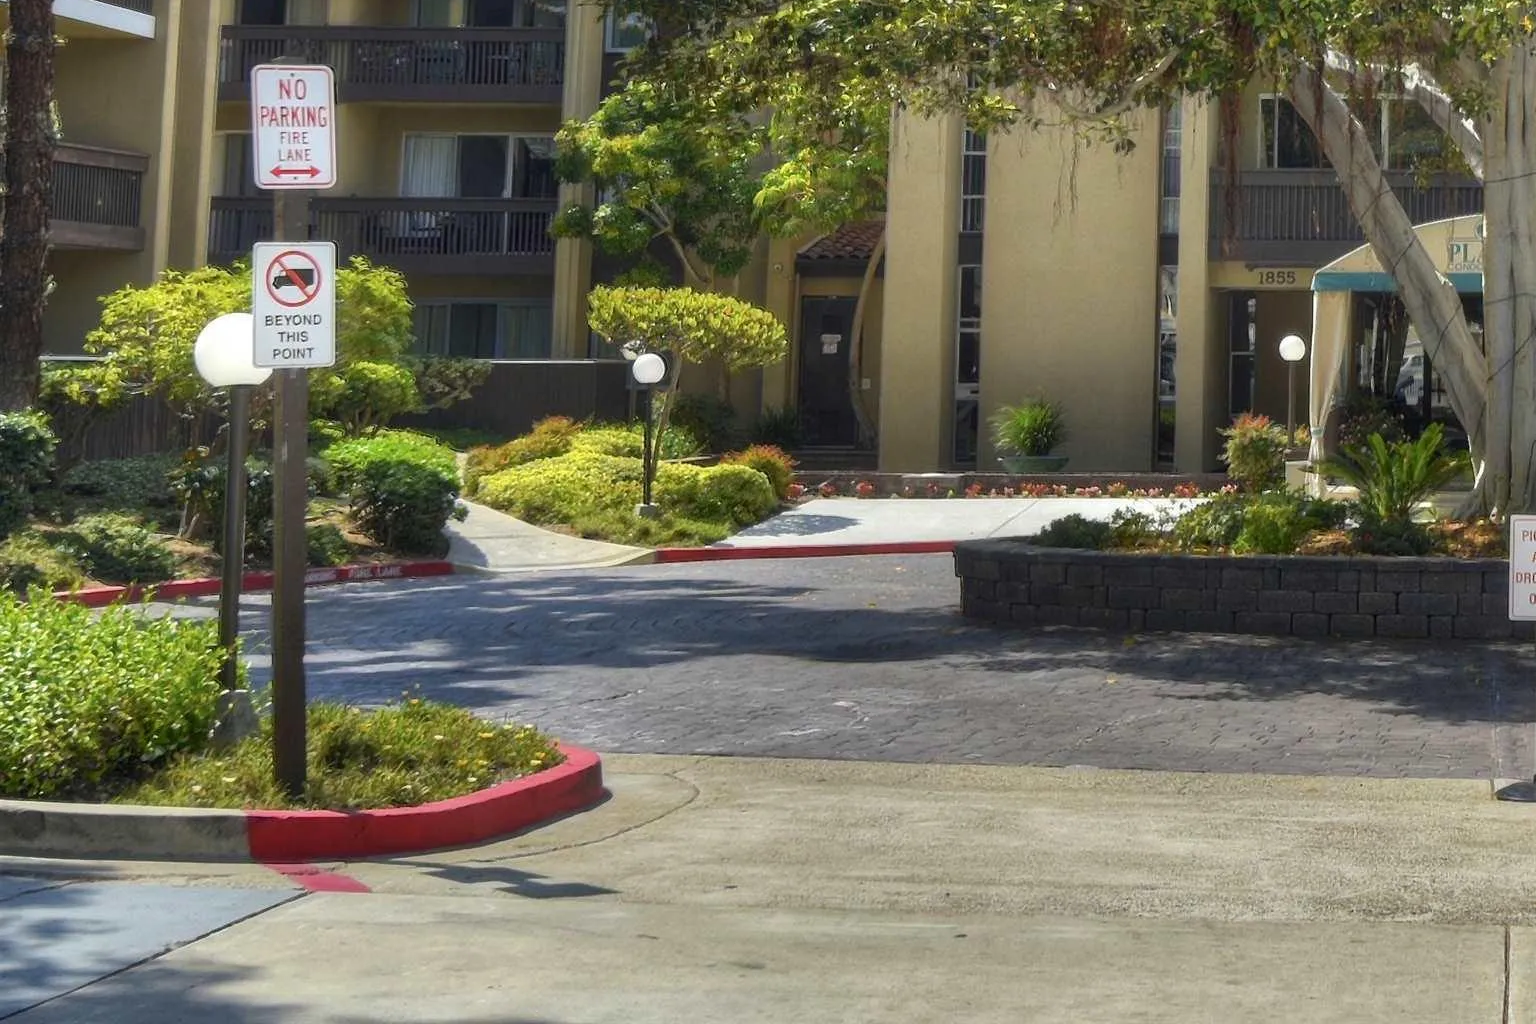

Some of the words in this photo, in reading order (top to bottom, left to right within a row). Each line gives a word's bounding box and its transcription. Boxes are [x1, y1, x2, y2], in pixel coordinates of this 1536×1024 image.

[278, 78, 307, 100] NO
[260, 106, 327, 128] PARKING
[280, 131, 309, 145] FIRE
[278, 148, 312, 162] LANE
[1258, 271, 1296, 285] 1855
[265, 314, 322, 326] BEYOND
[277, 330, 309, 343] THIS
[272, 347, 315, 360] POINT
